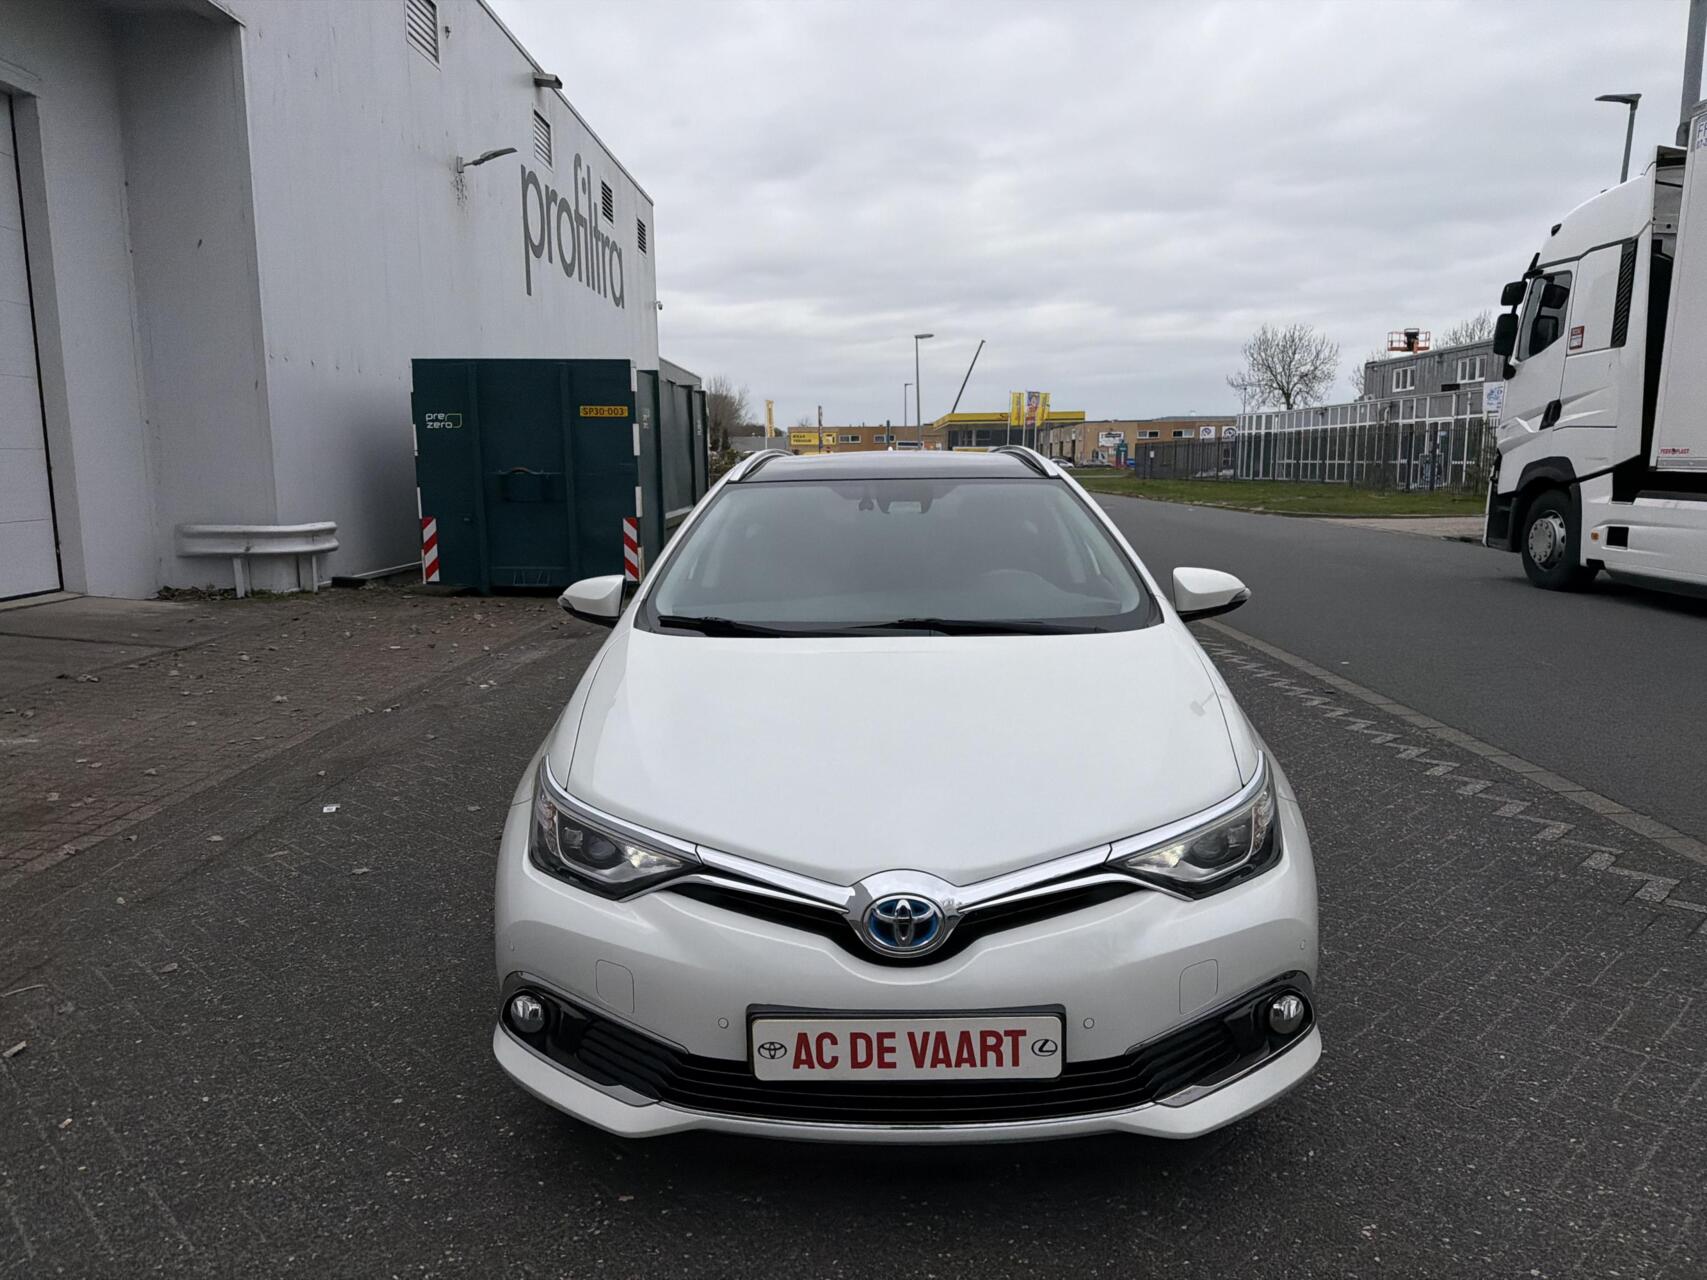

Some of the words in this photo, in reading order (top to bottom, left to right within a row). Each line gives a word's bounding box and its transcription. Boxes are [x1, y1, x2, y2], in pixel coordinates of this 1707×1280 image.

[520, 153, 625, 309] profiltra
[425, 413, 445, 422] pre
[426, 421, 453, 429] zero
[792, 1031, 839, 1070] AC
[850, 1031, 897, 1069] DE
[907, 1029, 1027, 1069] VAART
